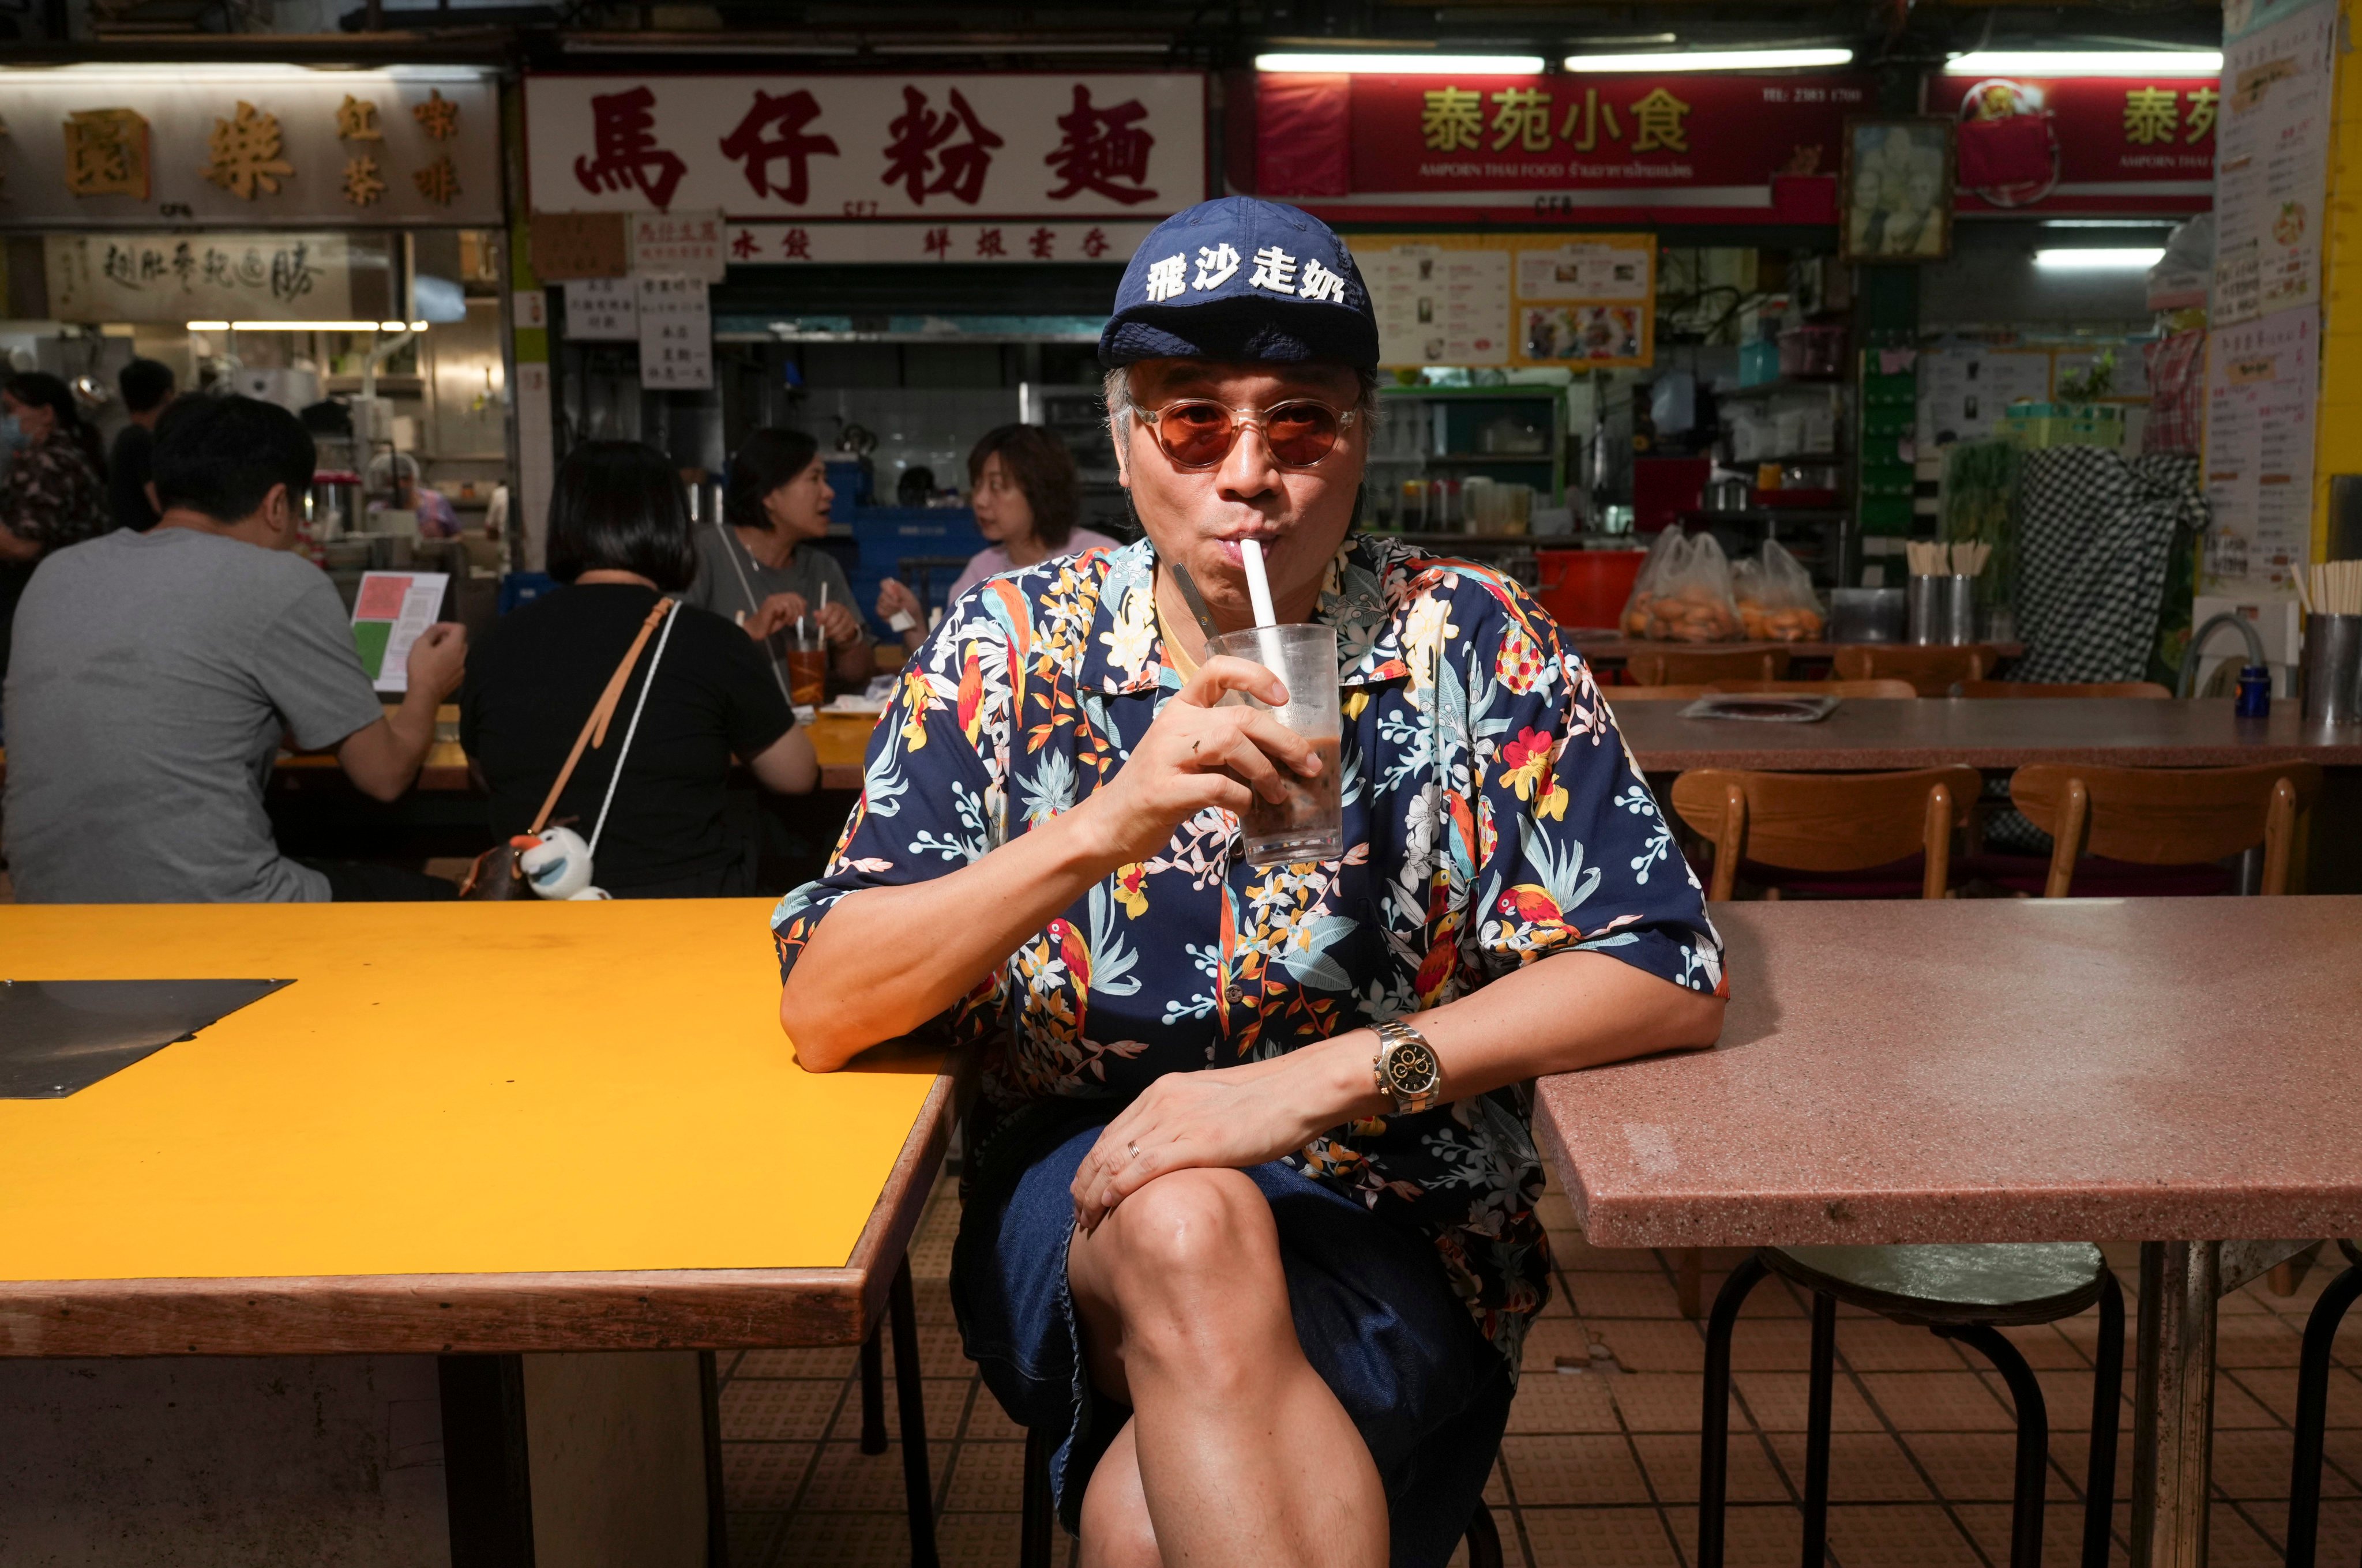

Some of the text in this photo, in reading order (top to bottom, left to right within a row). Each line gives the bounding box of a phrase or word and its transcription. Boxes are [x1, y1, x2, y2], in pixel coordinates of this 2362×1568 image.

[0, 100, 296, 201] 樂園
[337, 93, 388, 206] 紅茶
[573, 84, 1159, 211] 馬仔粉麵
[1420, 85, 1691, 155] 泰苑小食
[1485, 163, 1518, 178] THAI
[1521, 162, 1564, 177] FOOD
[731, 229, 812, 261] 水餃
[923, 227, 1110, 261] 鮮蝦雲吞
[1146, 243, 1345, 304] 飛沙走奶
